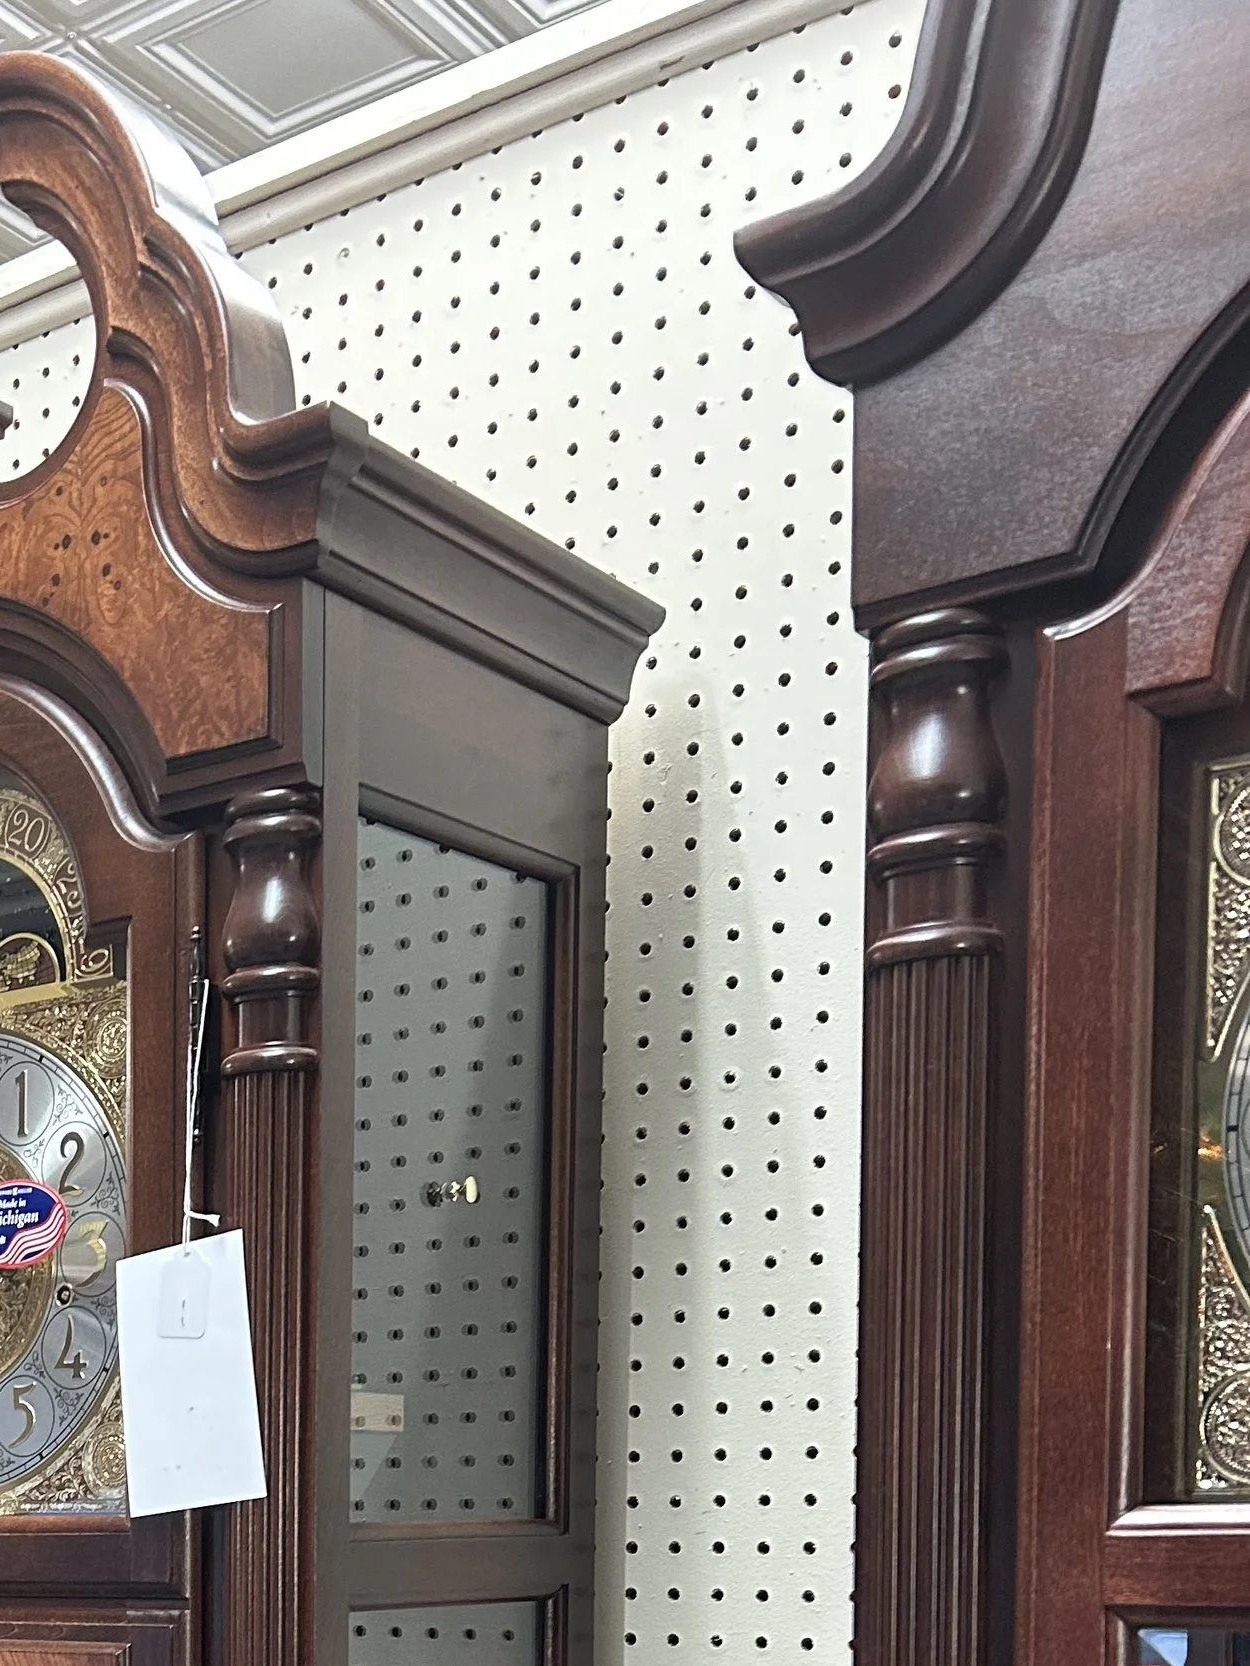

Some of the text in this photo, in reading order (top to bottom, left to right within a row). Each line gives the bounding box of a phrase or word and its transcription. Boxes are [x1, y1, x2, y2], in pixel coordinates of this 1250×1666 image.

[9, 807, 45, 853] 20
[15, 1068, 29, 1138] 1
[58, 1130, 86, 1198] 2
[18, 1197, 27, 1207] in
[74, 1217, 109, 1289] 3
[54, 1312, 89, 1380] 4
[8, 1380, 38, 1449] 5
